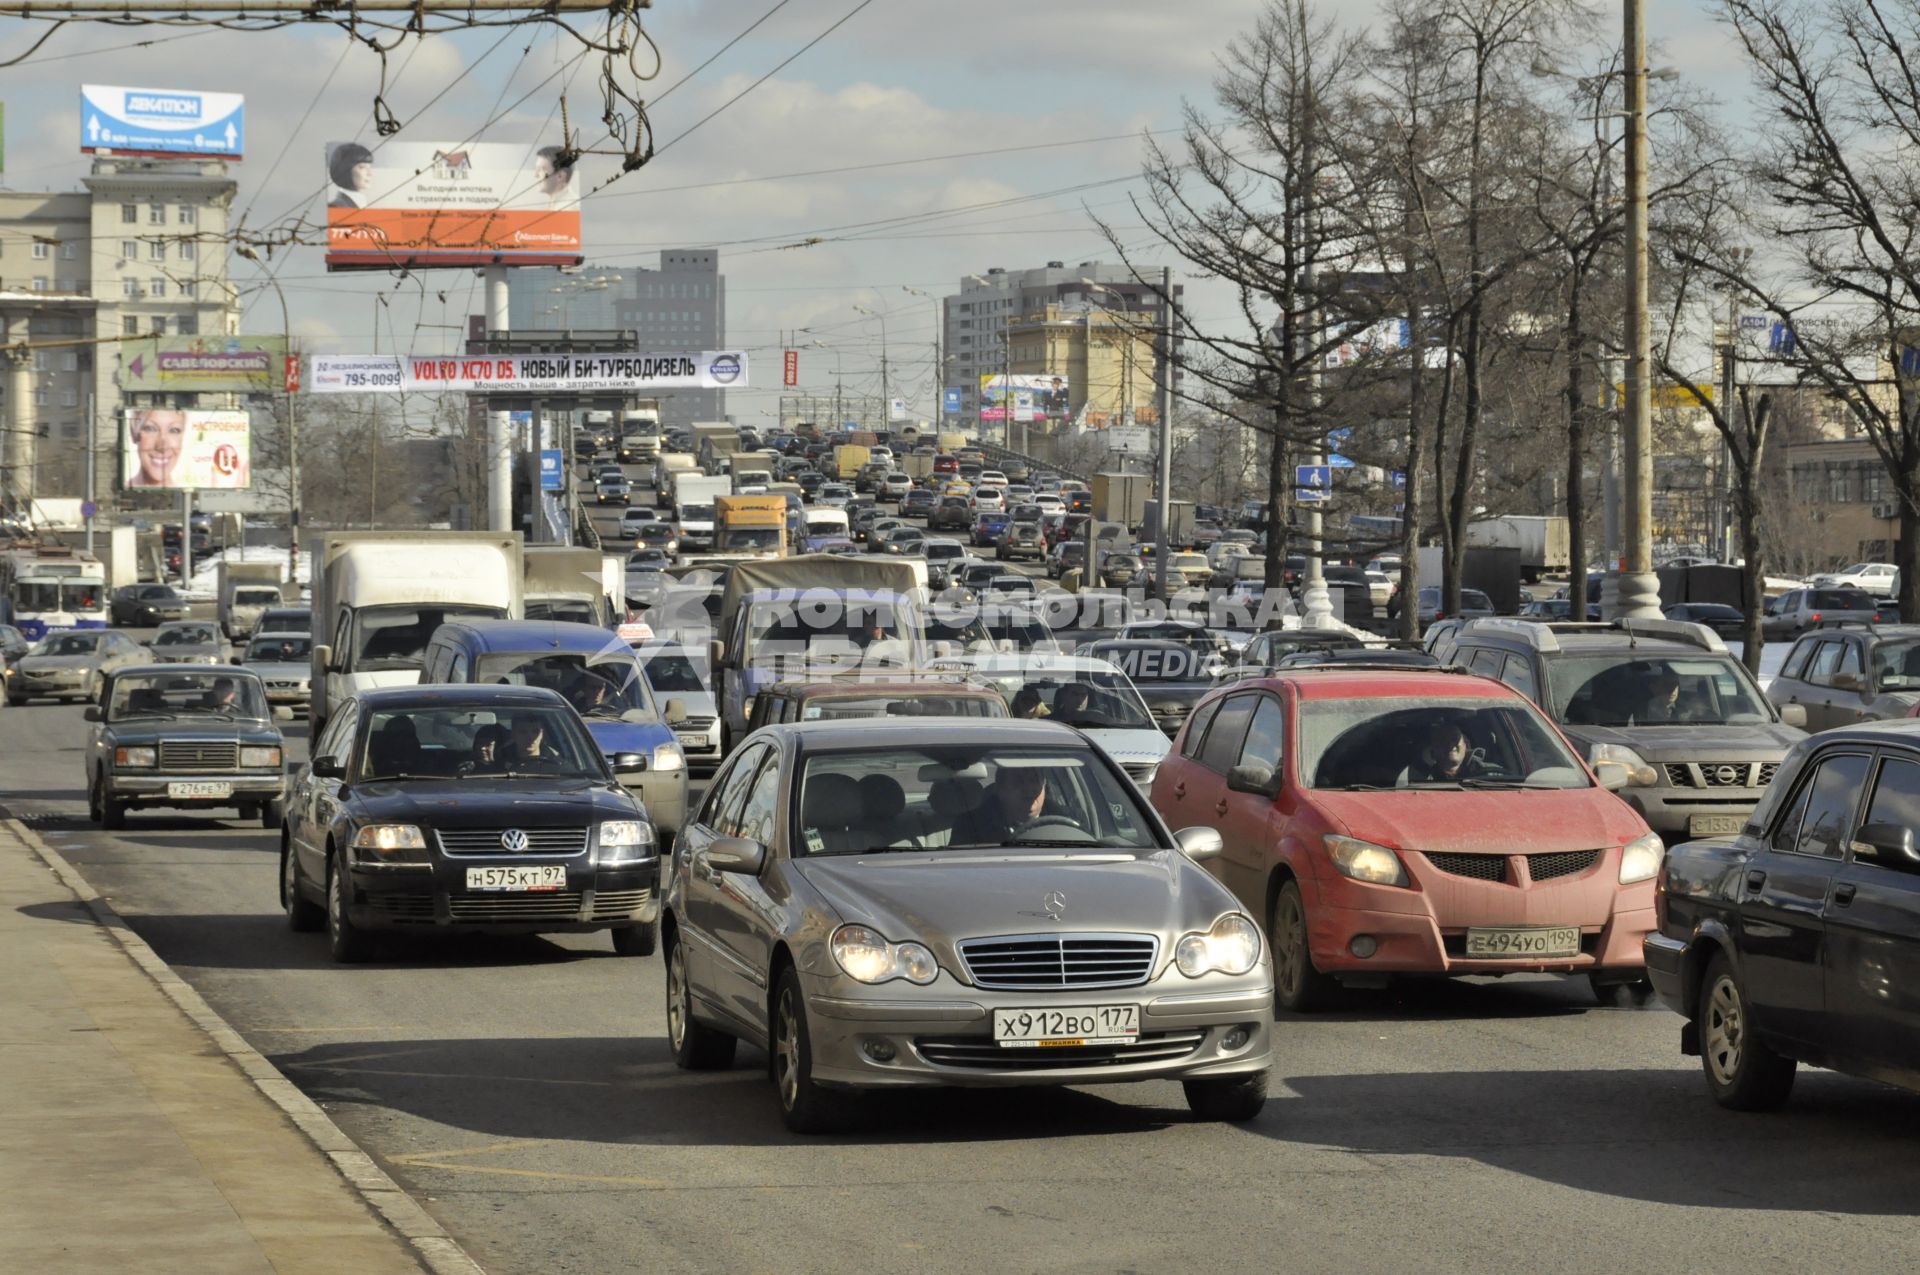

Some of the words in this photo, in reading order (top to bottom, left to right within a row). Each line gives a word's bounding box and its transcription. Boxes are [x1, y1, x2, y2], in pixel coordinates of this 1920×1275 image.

[101, 128, 111, 142] 6
[417, 184, 458, 194] Выгодная
[414, 361, 457, 380] VOLVO
[461, 360, 492, 380] XC70
[520, 355, 570, 379] НОВЫЙ
[574, 357, 696, 380] БИ-ТУРБОДИЗЕЛЬ
[345, 373, 400, 386] 795-0099
[474, 381, 527, 390] Мощность
[529, 381, 557, 389] выше
[565, 381, 607, 389] затраты
[609, 380, 636, 388] ниже
[1694, 818, 1747, 833] С133А
[474, 869, 539, 886] Н575КТ
[544, 867, 560, 880] 97
[1473, 933, 1546, 952] Е494УО
[1549, 930, 1574, 945] 199
[1003, 1011, 1095, 1037] Х912ВО
[1100, 1007, 1134, 1027] 177
